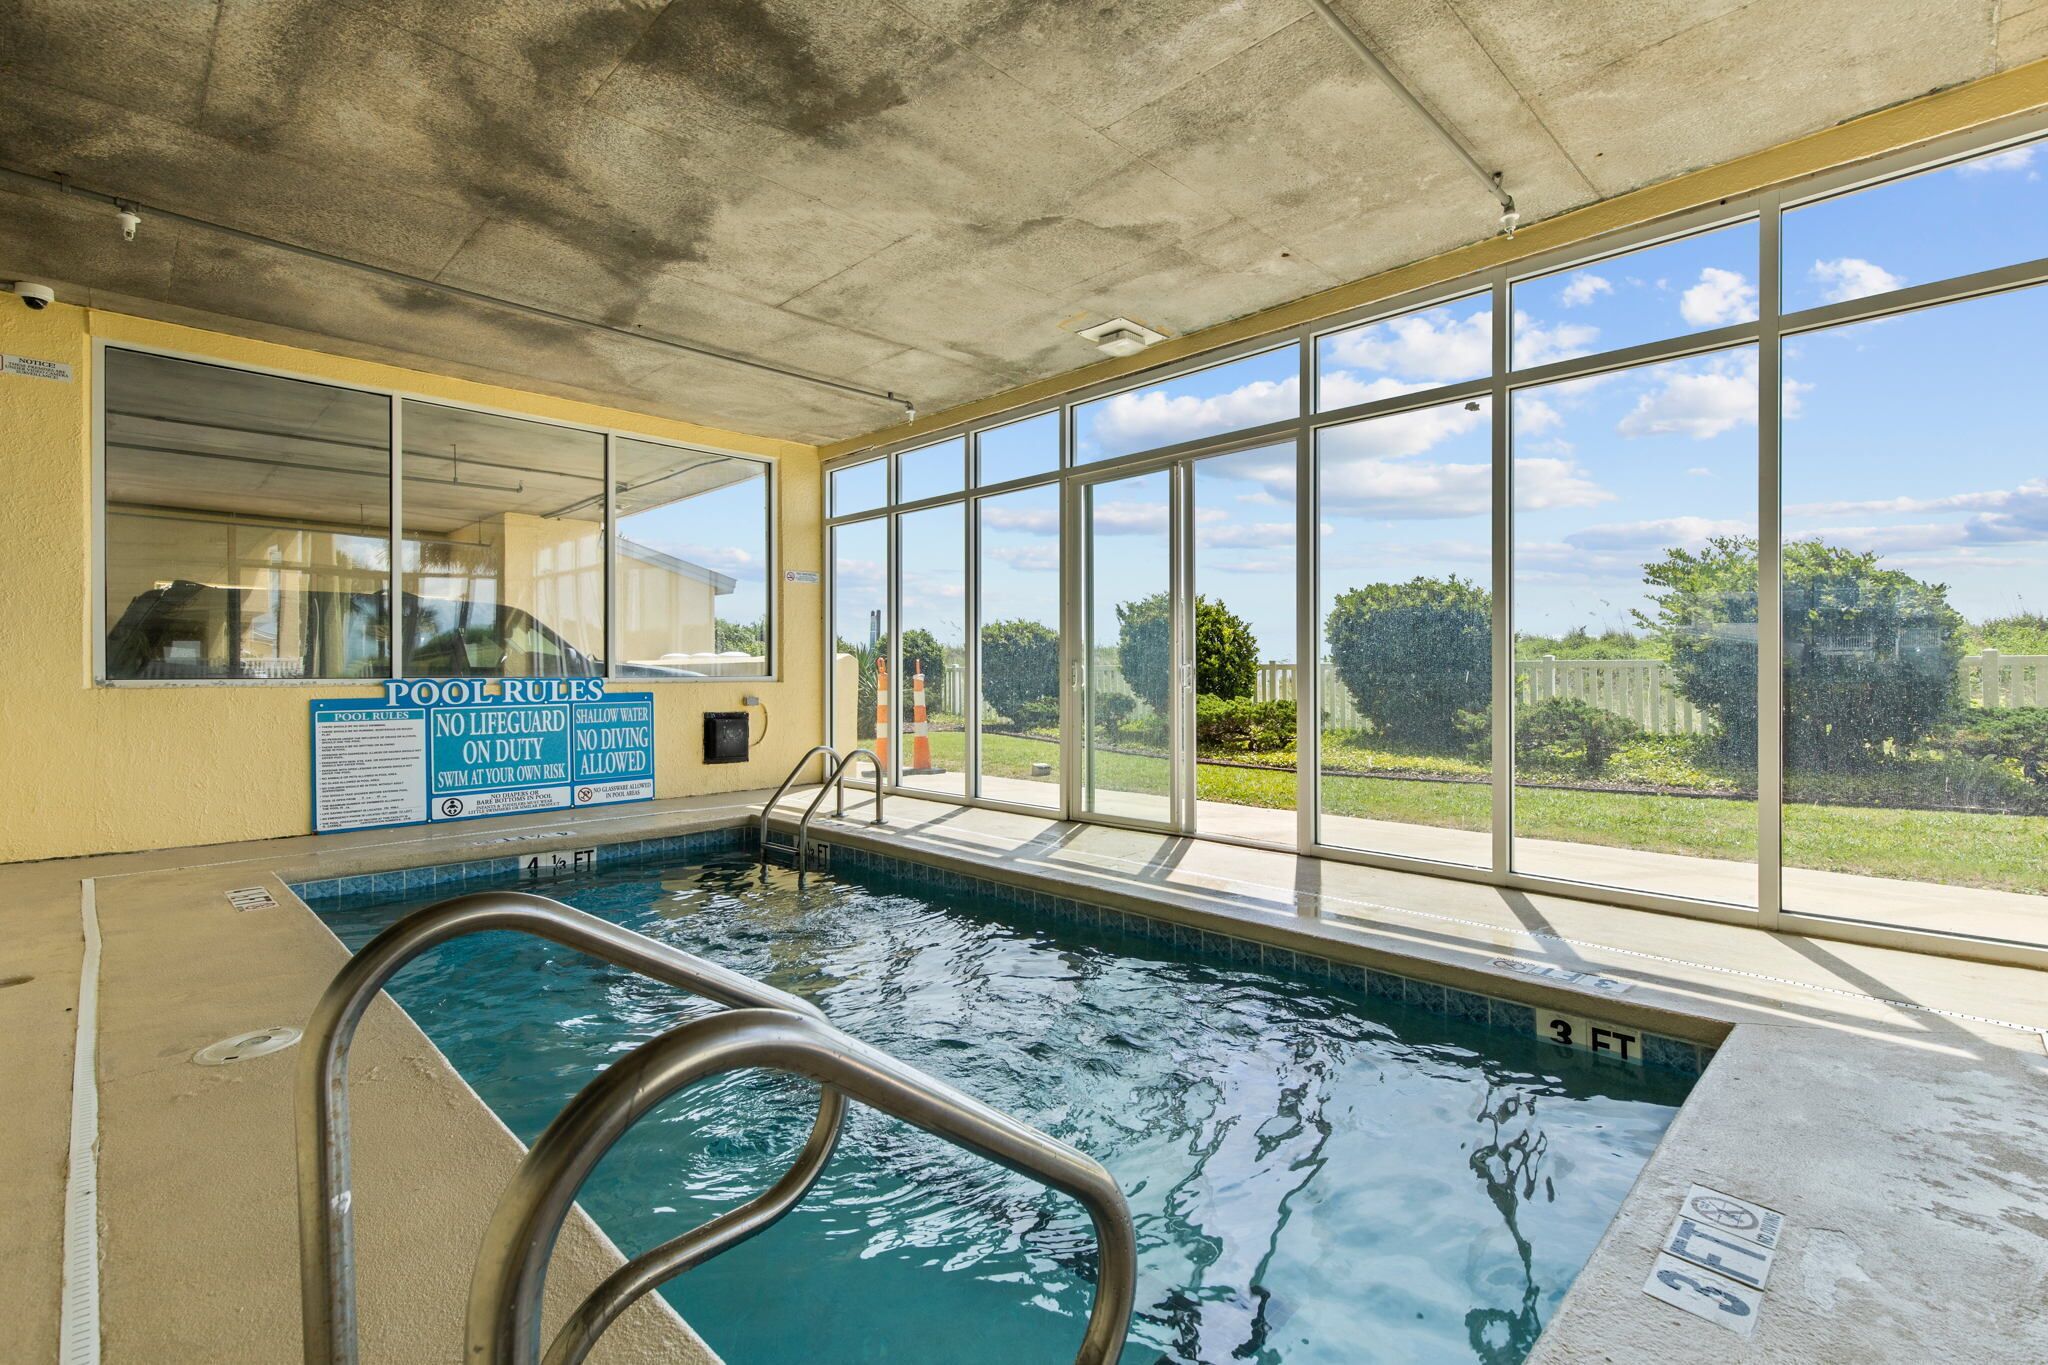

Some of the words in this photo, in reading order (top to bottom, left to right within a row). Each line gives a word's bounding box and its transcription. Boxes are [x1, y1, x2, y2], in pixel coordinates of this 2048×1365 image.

[19, 358, 56, 368] NOTICE!
[386, 681, 492, 706] POOL
[503, 680, 603, 702] RULES
[335, 713, 369, 721] POOL
[373, 712, 408, 720] RULES
[436, 713, 465, 737] NO
[470, 710, 565, 735] LIFEGUARD
[576, 708, 619, 723] SHALLOW
[620, 707, 648, 722] WATER
[577, 729, 597, 750] NO
[601, 727, 648, 749] DIVING
[463, 740, 490, 764] ON
[496, 738, 544, 762] DUTY
[580, 750, 646, 775] ALLOWED
[438, 770, 468, 788] SWIM
[471, 769, 485, 785] AT
[486, 767, 514, 783] YOUR
[517, 765, 542, 781] OWN
[544, 763, 565, 779] RISK
[526, 857, 538, 869] 4
[574, 850, 594, 865] FT
[818, 844, 828, 858] FT
[1539, 968, 1581, 981] FT
[1594, 979, 1618, 989] 3
[1550, 1020, 1572, 1044] 3
[1592, 1027, 1635, 1060] FT
[1759, 1212, 1781, 1234] DIVING
[1756, 1233, 1774, 1246] NO
[1670, 1220, 1766, 1285] FT
[1656, 1269, 1750, 1316] 3
